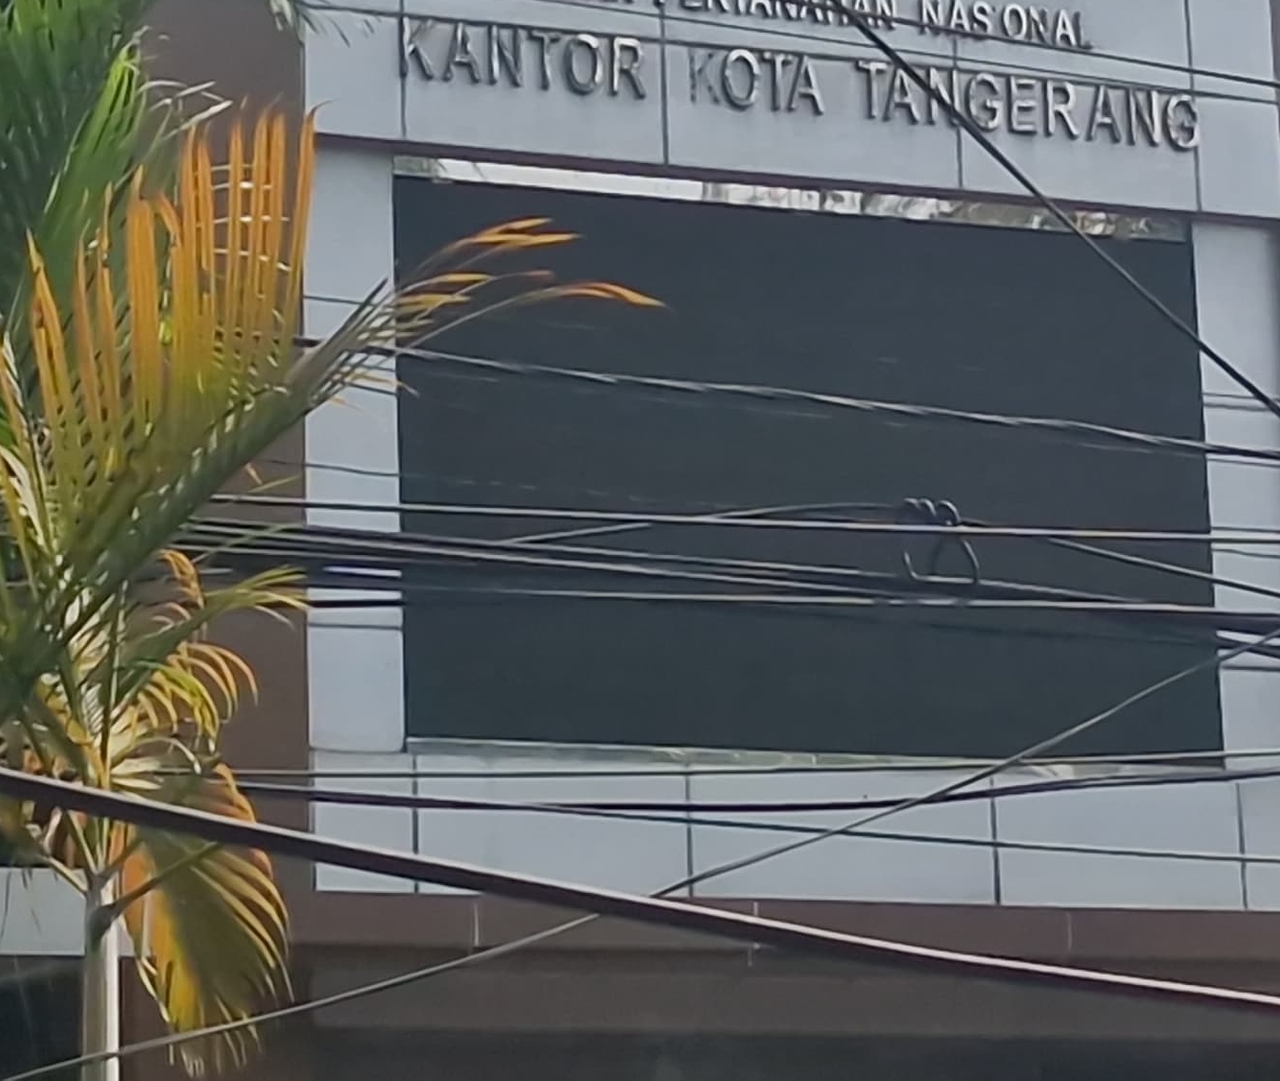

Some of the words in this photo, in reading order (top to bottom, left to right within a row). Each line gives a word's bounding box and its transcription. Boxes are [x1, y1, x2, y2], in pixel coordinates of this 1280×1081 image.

[400, 16, 647, 100] KANTOR
[687, 47, 825, 117] KOTA
[857, 59, 1201, 150] TANGERANG
